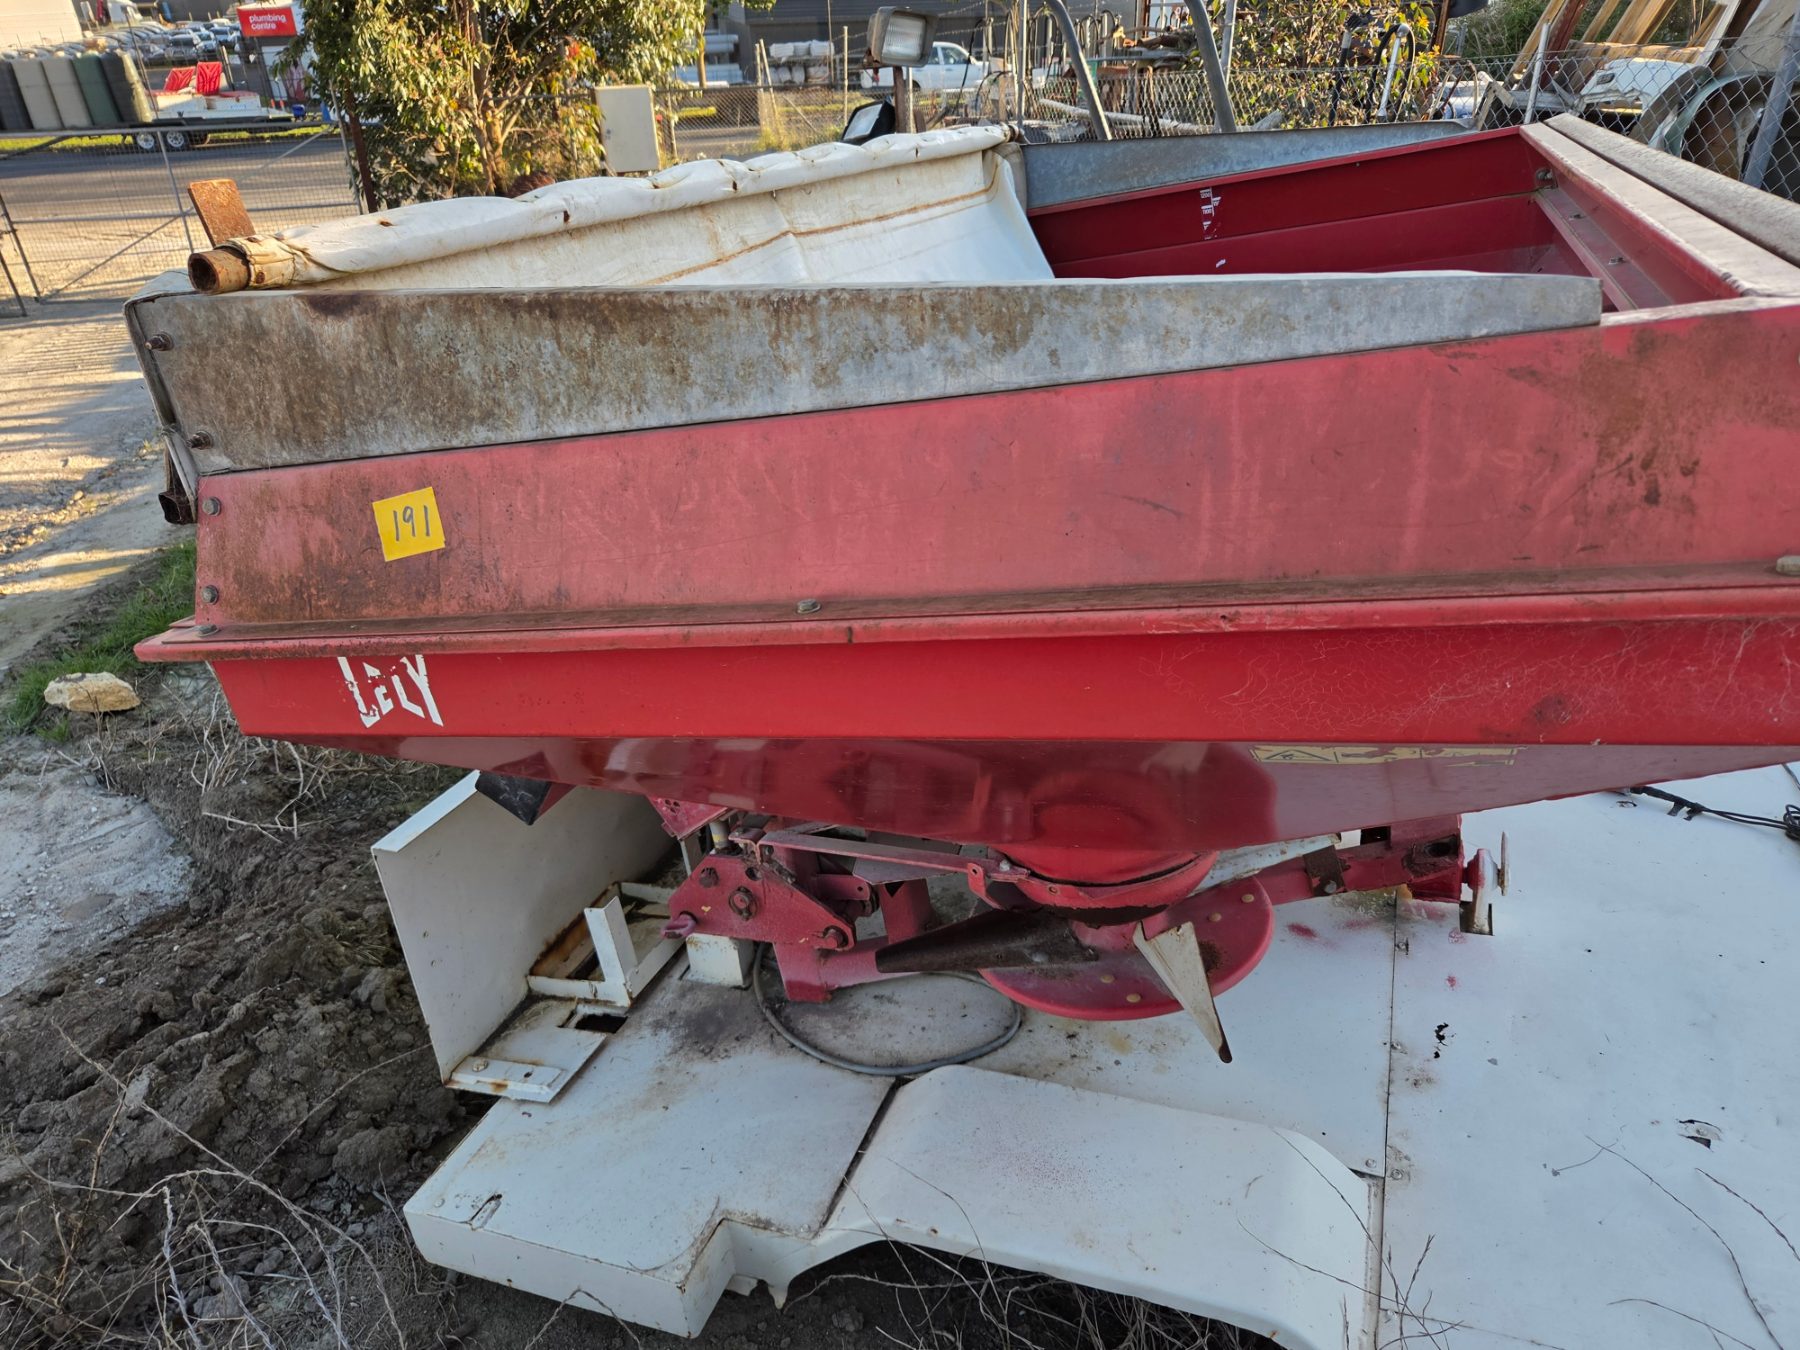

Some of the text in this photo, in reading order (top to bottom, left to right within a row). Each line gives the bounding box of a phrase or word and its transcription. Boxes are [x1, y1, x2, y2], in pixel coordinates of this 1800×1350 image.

[249, 14, 287, 24] plumbing
[251, 22, 276, 30] centre
[393, 505, 431, 541] 191
